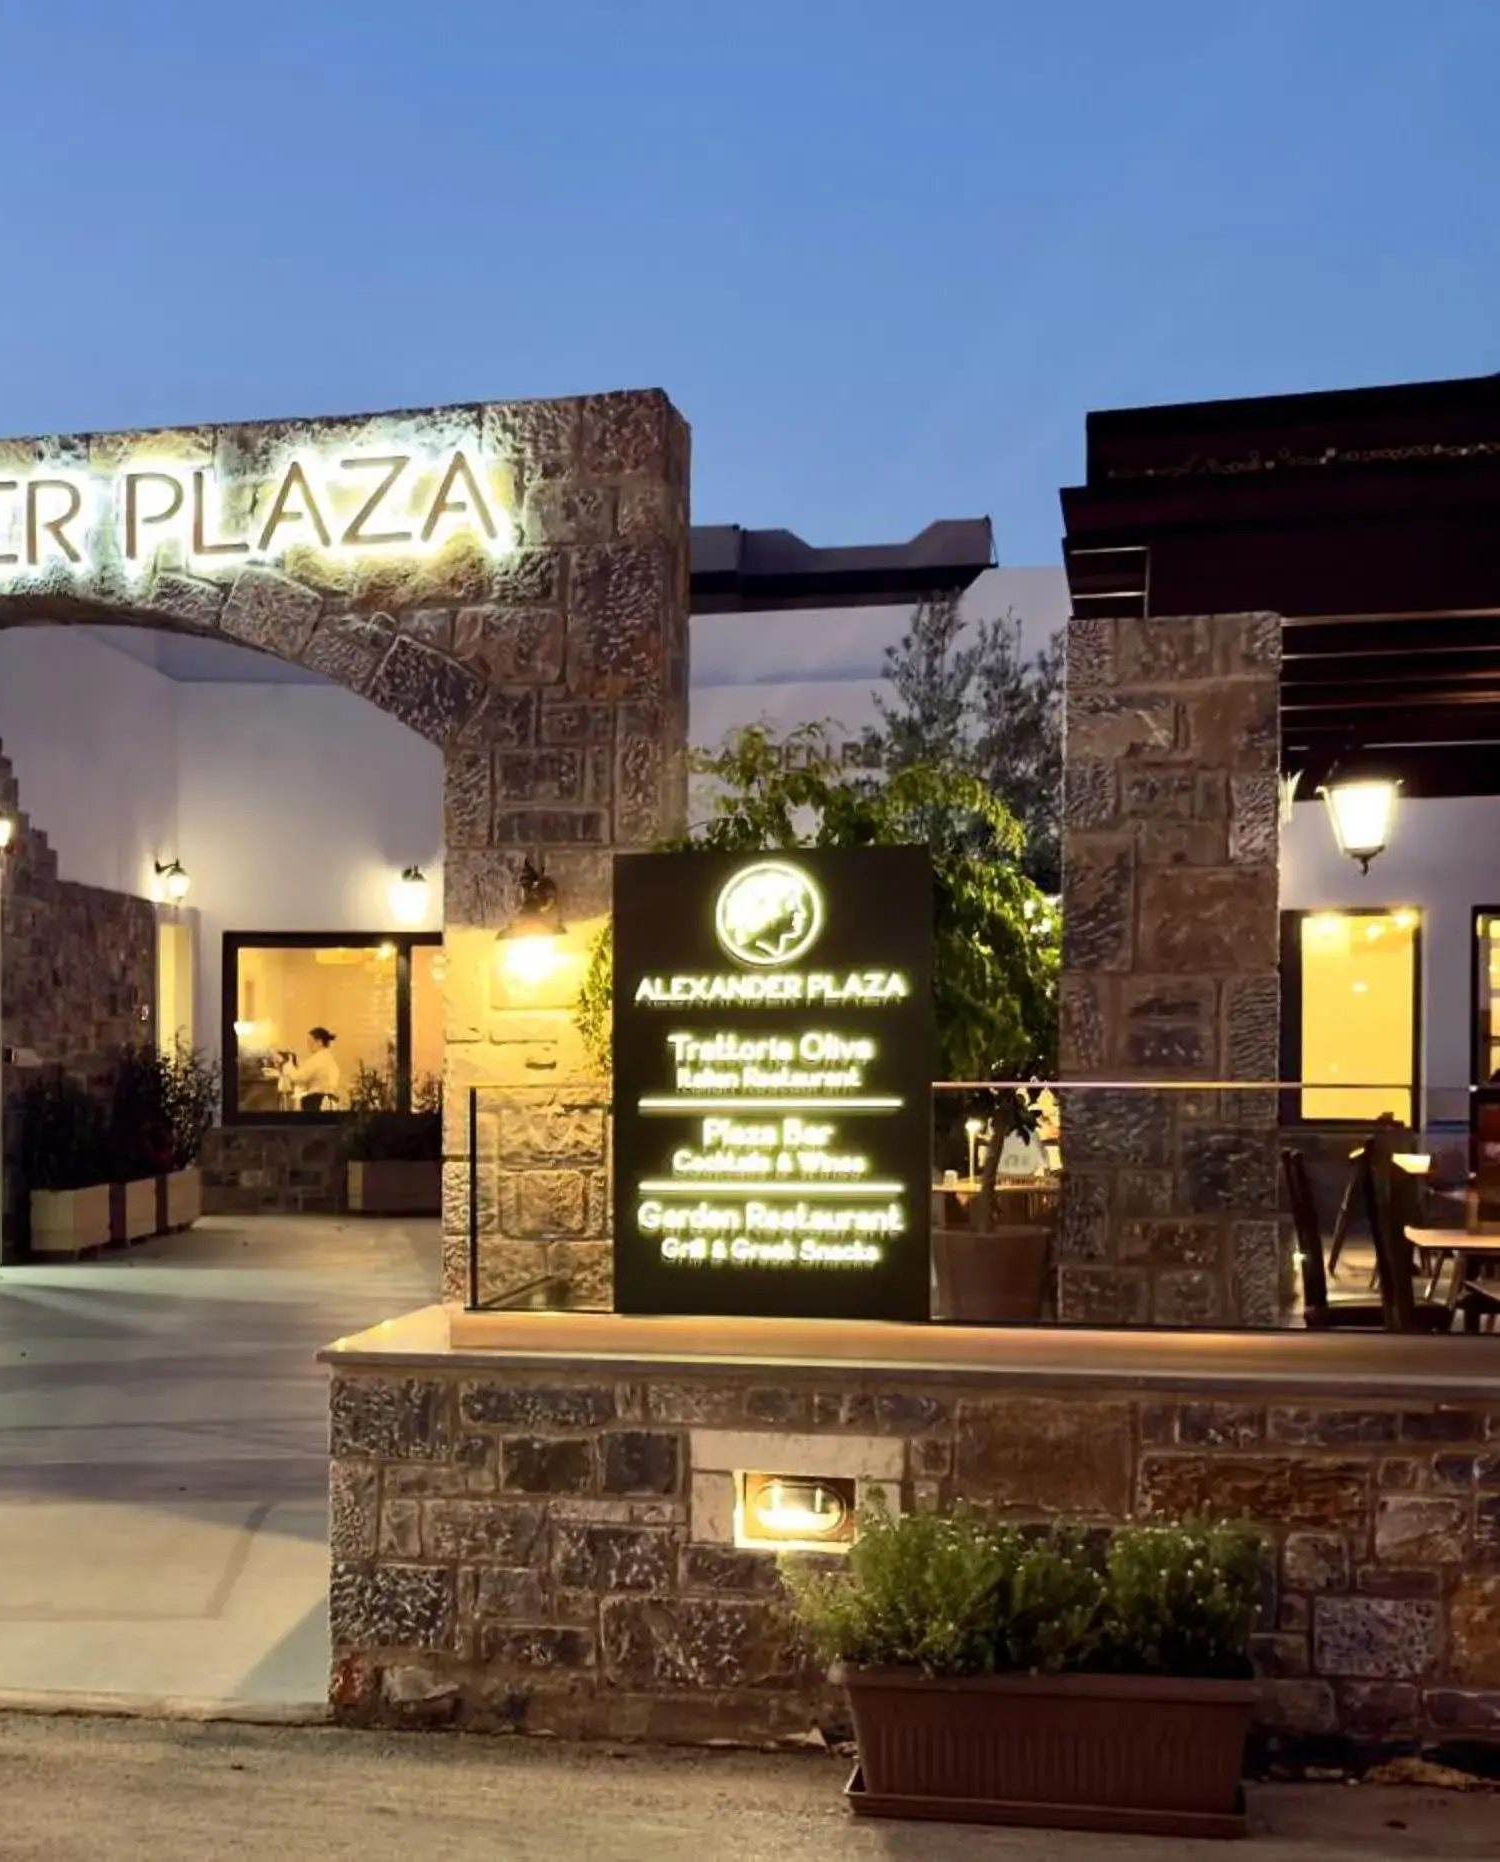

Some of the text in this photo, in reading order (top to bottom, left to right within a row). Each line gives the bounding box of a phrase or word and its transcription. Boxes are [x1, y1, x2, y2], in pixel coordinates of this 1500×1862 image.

[124, 449, 498, 561] PLAZA
[635, 973, 906, 1001] ALEXANDER PLAZA
[667, 1033, 793, 1061] Trattoria
[742, 1066, 861, 1087] Restaurant
[702, 1117, 834, 1146] Plaza Bar
[797, 1150, 867, 1173] Wines
[638, 1201, 904, 1231] Garden Restaurant
